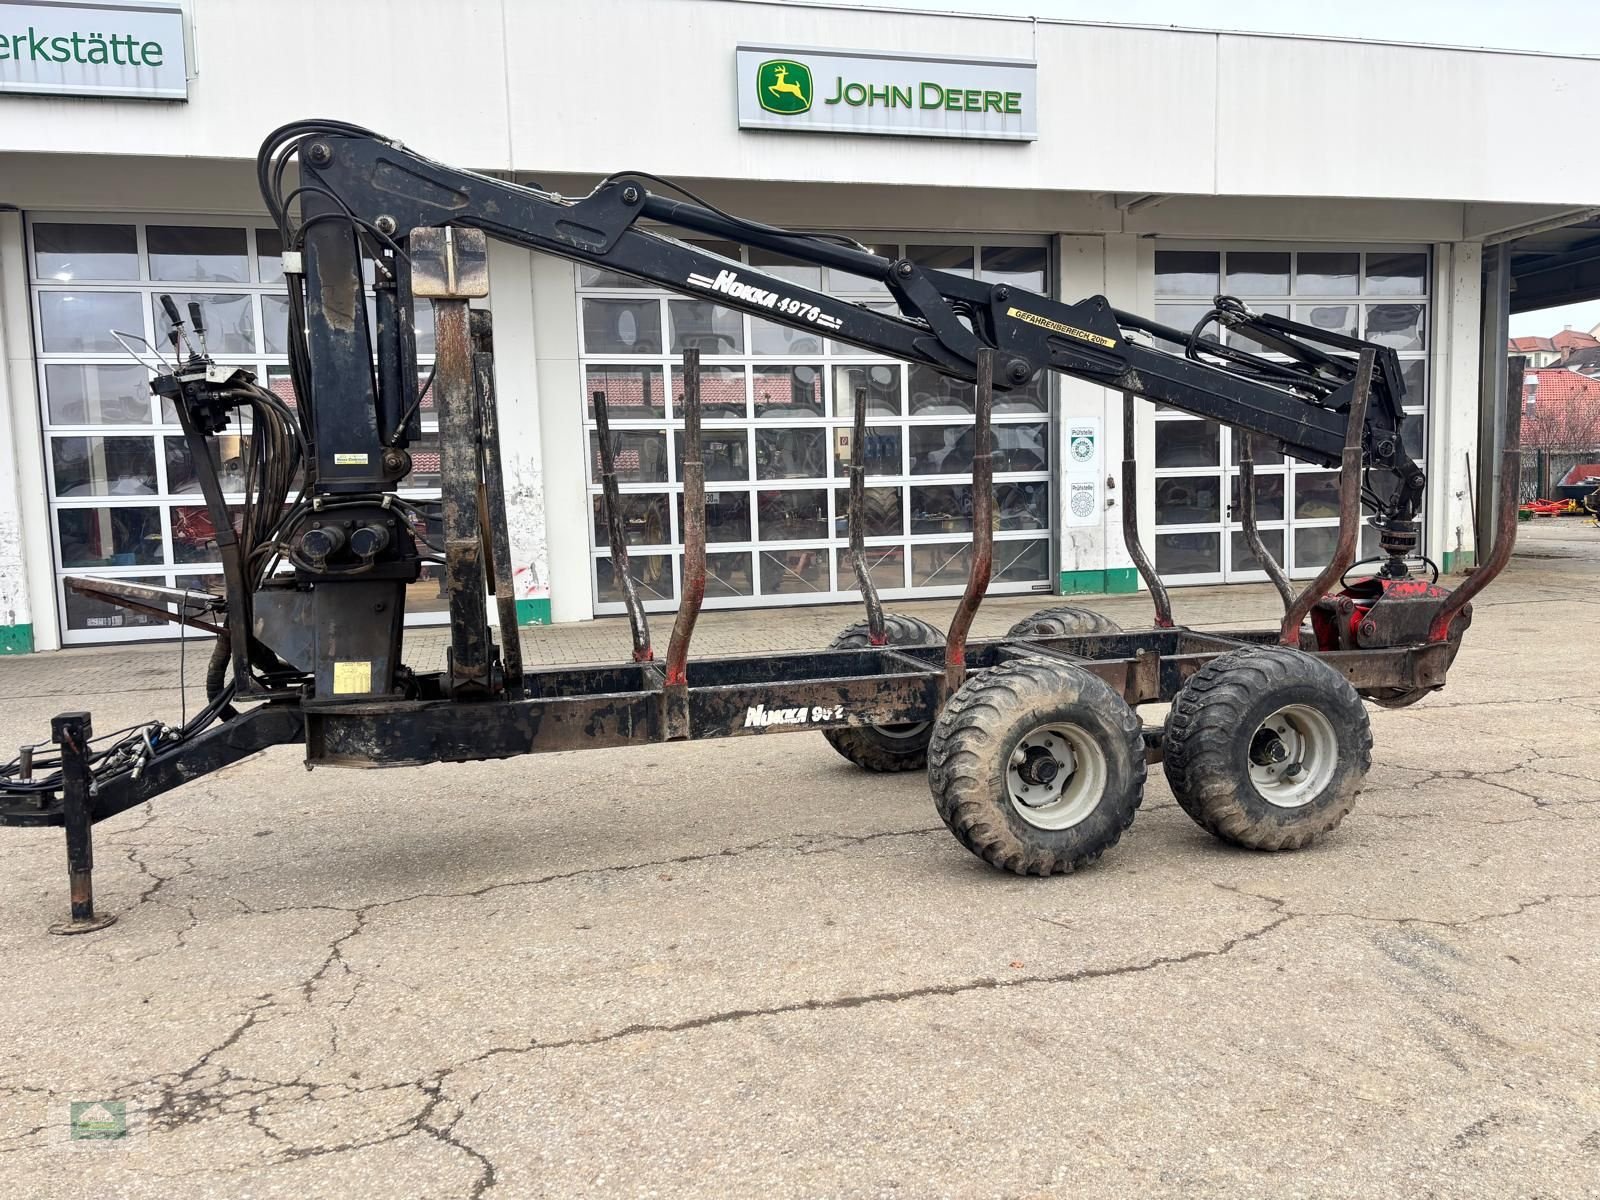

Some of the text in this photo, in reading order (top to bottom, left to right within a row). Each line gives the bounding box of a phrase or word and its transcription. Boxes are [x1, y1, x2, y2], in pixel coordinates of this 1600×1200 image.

[824, 77, 1022, 114] JOHN DEERE
[1014, 310, 1090, 339] GEFAHRENBEREICH
